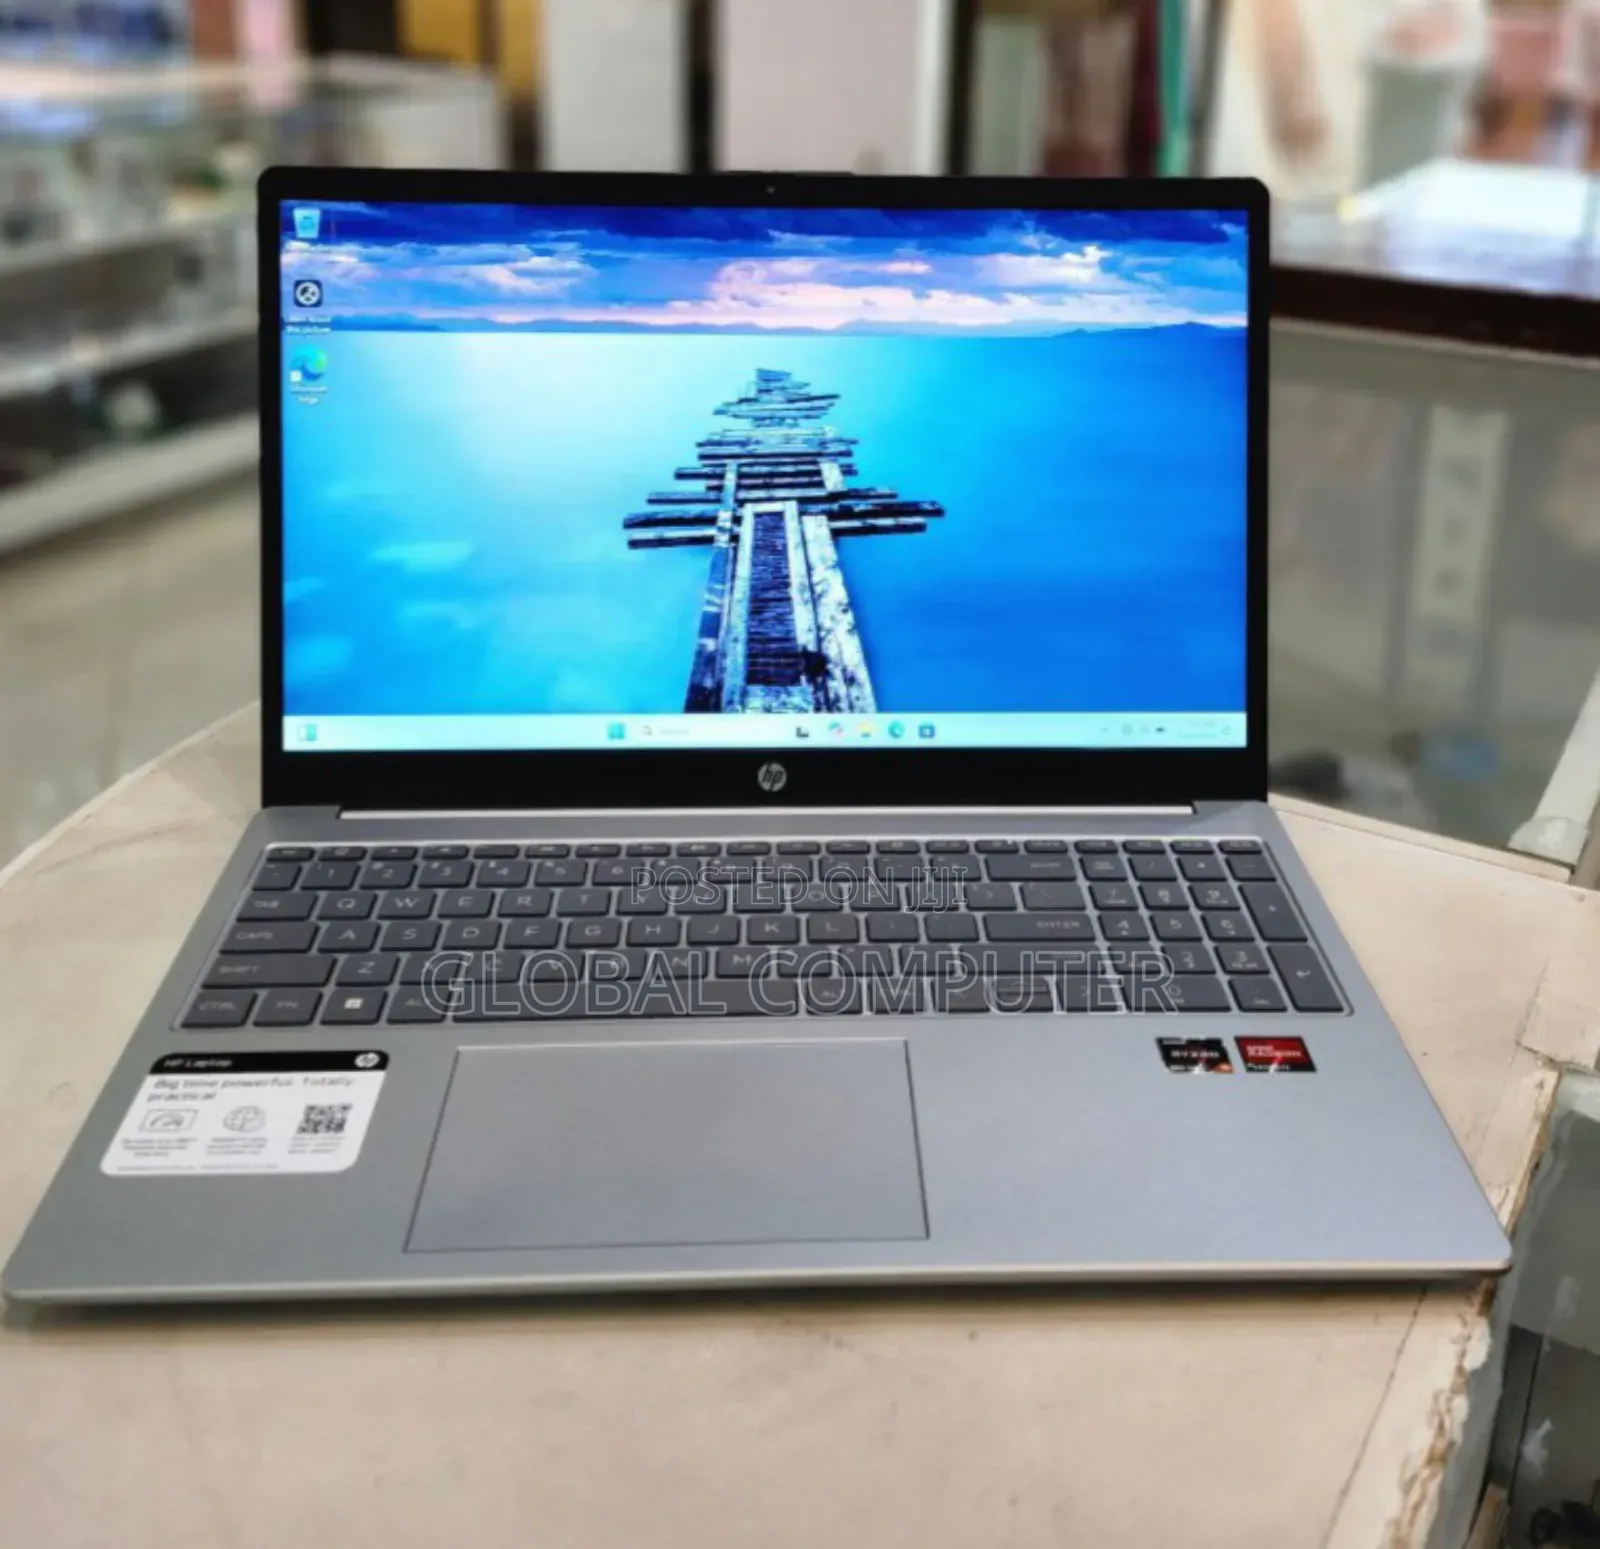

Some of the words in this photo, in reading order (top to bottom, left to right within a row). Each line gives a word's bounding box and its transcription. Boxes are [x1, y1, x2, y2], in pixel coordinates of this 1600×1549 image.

[760, 762, 785, 791] hp
[336, 898, 356, 909] Q
[394, 897, 419, 908] W
[516, 895, 532, 906] R
[524, 926, 541, 937] F
[584, 925, 602, 936] G
[645, 925, 661, 935] H
[706, 924, 720, 934] J
[763, 922, 780, 933] K
[825, 921, 840, 931] L
[338, 929, 357, 940] A
[402, 928, 418, 940] S
[461, 927, 480, 939] D
[357, 961, 376, 974] Z
